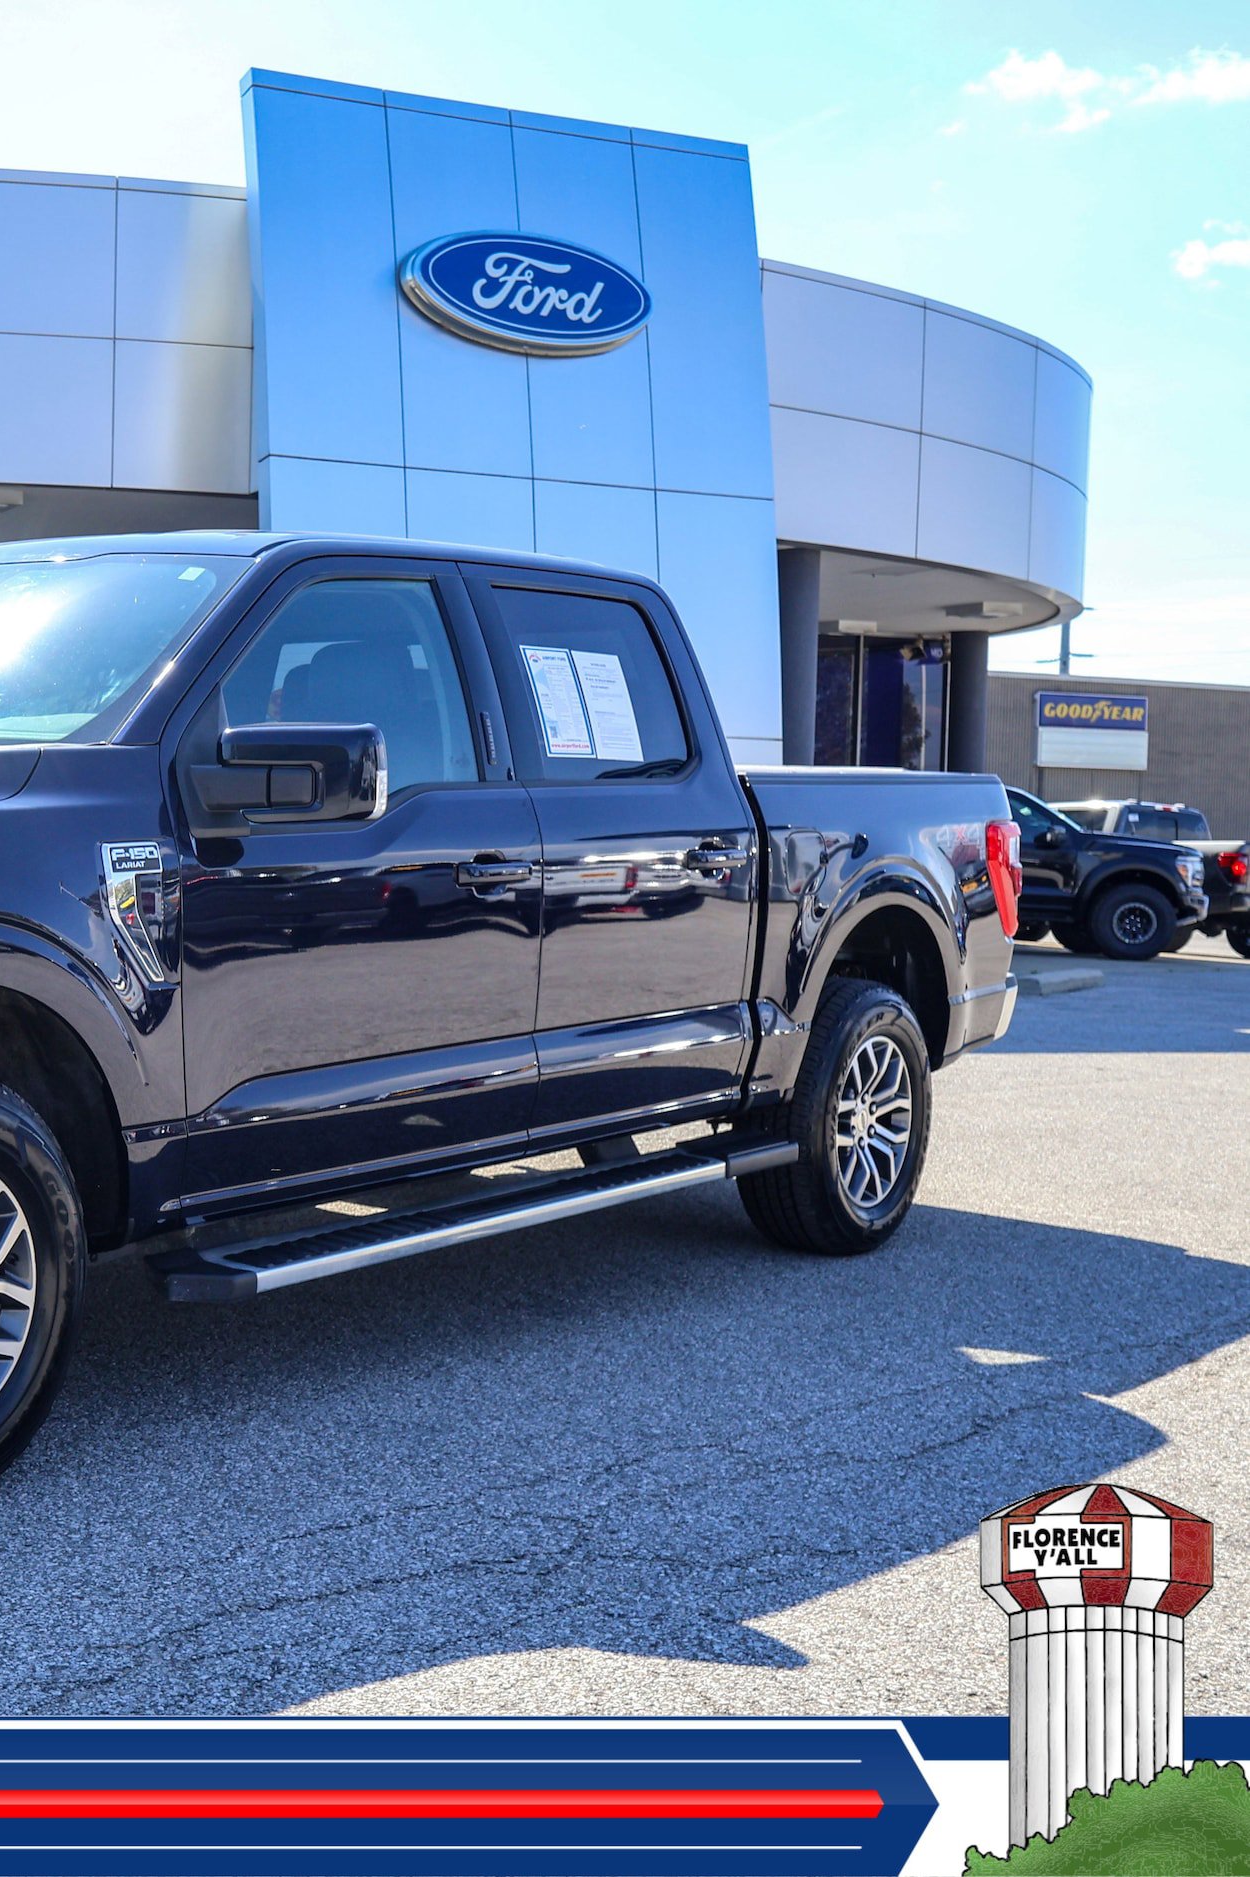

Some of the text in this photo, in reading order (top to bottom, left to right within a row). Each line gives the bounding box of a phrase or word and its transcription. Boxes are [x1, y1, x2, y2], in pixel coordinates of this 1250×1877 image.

[472, 252, 605, 324] Ford
[1044, 700, 1145, 723] GOODYEAR
[111, 846, 158, 860] F-150
[116, 861, 145, 869] LARIAT
